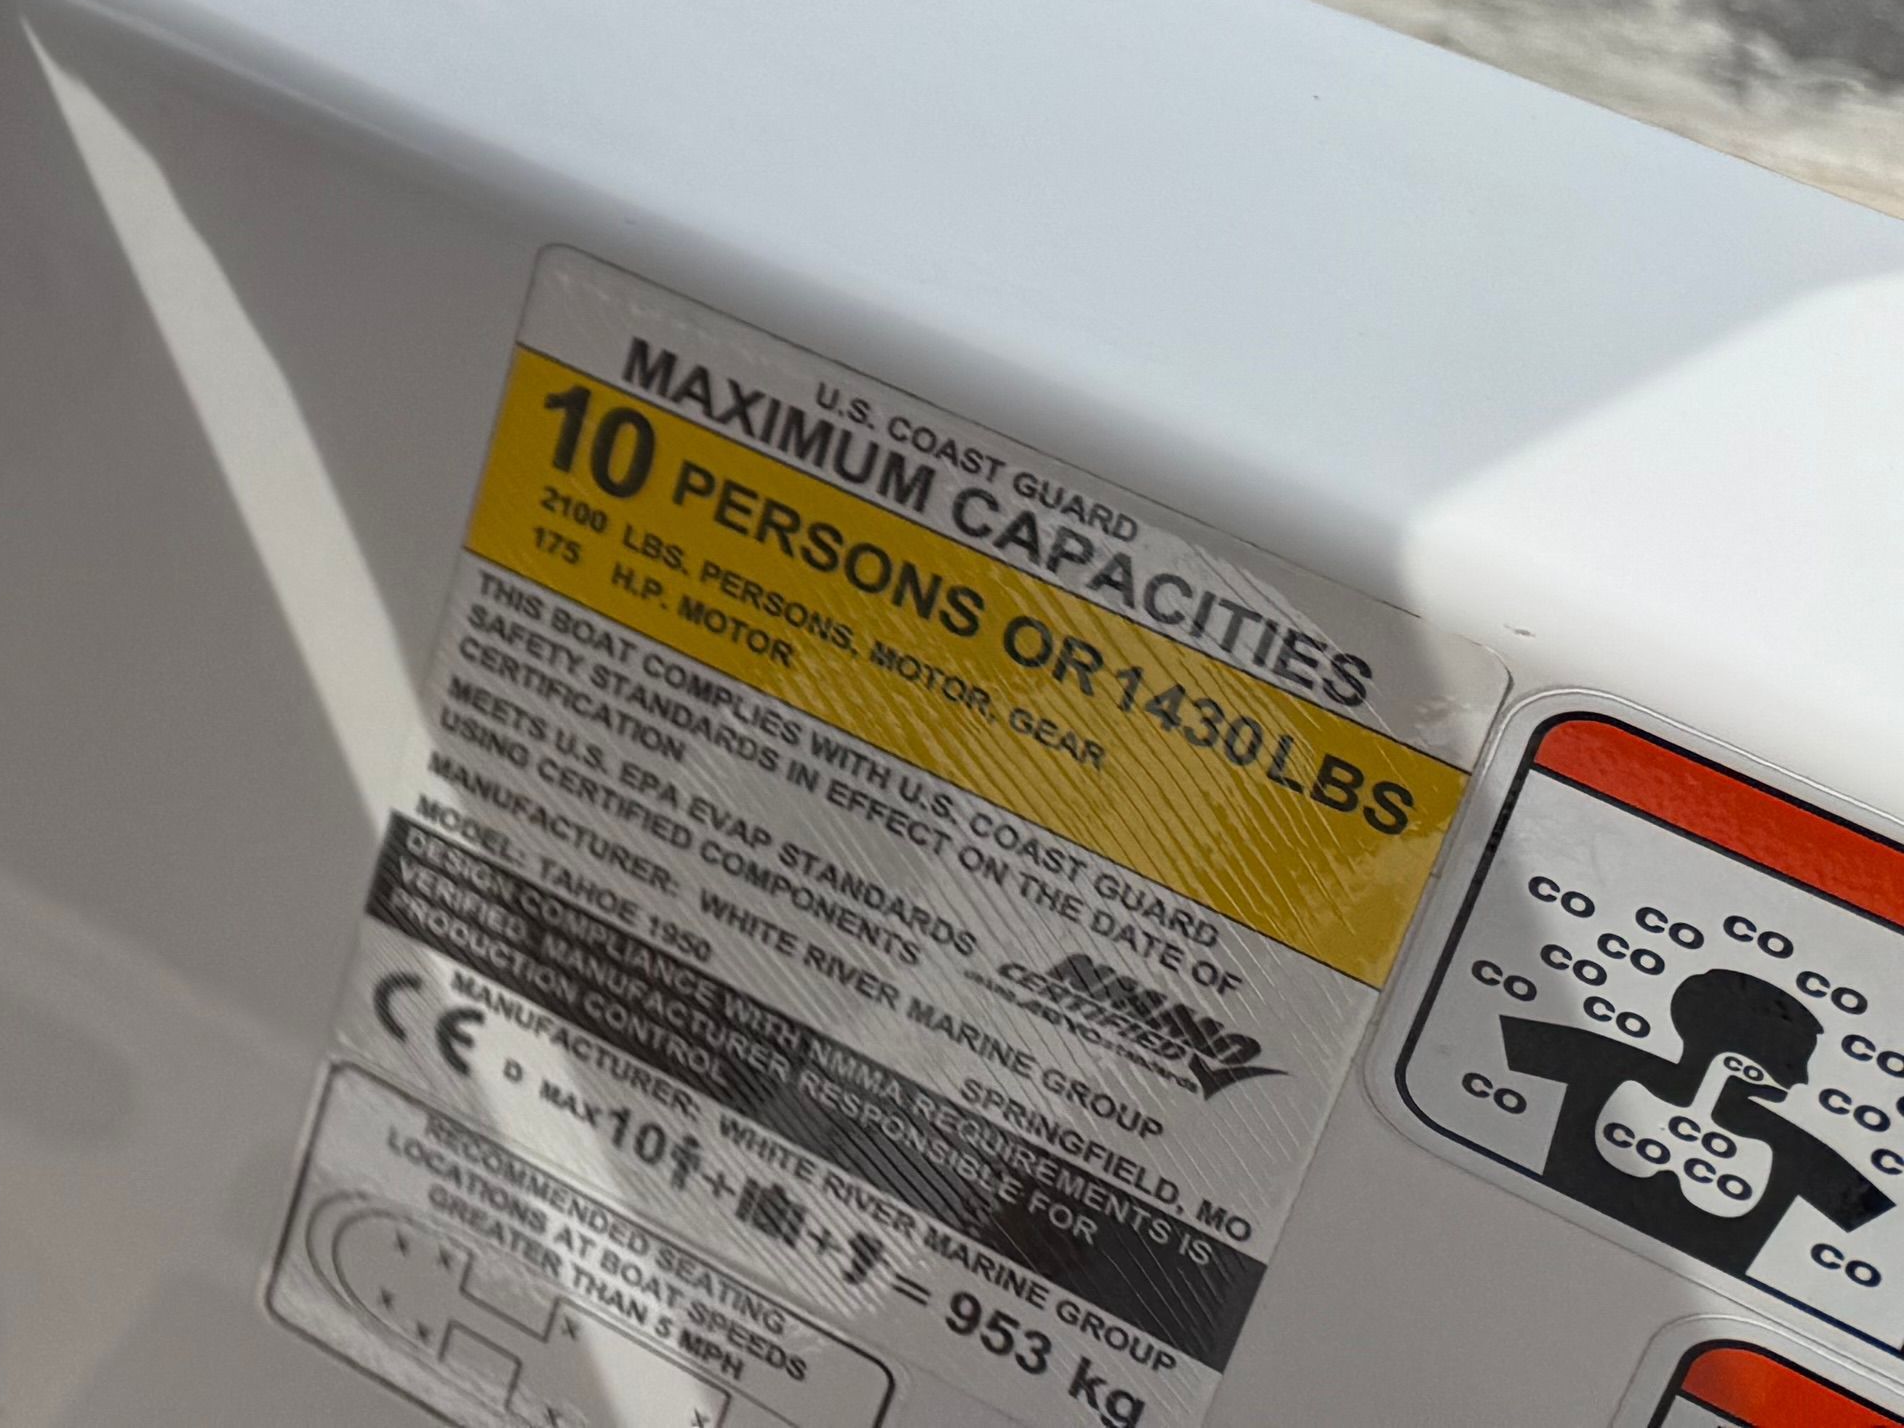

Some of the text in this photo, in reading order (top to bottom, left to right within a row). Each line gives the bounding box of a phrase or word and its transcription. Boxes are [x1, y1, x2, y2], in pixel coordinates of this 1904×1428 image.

[812, 380, 1142, 546] U.S. COAST GUARD
[620, 334, 1379, 713] MAXIMUM CAPACITIES
[527, 522, 796, 670] 175 H.P. MOTOR
[538, 484, 609, 536] 2100
[620, 523, 693, 576] LBS.
[1007, 704, 1108, 771] GEAR
[542, 383, 658, 501] 10
[669, 457, 991, 643] PERSONS
[997, 608, 1110, 698] OR
[1264, 731, 1420, 841] LBS
[456, 632, 688, 766] CERTIFICATION
[465, 600, 1243, 1002] SAFETY STANDARDS IN EFFECT ON THE DATE OF
[473, 568, 1222, 951] THIS BOAT COMPLIES WITH U.S. COAST GUARD
[437, 704, 925, 969] USING CERTIFIED COMPONENTS
[446, 672, 550, 744] MEETS
[616, 758, 684, 811] EPA
[686, 793, 773, 856] EVAP
[775, 837, 980, 959] STANDARDS
[1528, 876, 1595, 918] CO
[1635, 907, 1705, 949] CO
[1723, 915, 1794, 958] CO
[1471, 960, 1537, 1001] CO
[1540, 944, 1608, 986] CO
[1597, 933, 1665, 975] CO
[1795, 971, 1868, 1015] CO
[695, 886, 798, 957] WHITE
[802, 942, 902, 1010] RIVER
[906, 995, 1038, 1080] MARINE
[1040, 1064, 1165, 1145] GROUP
[1583, 996, 1651, 1038] CO
[1841, 1034, 1904, 1077] CO
[1462, 1072, 1527, 1114] CO
[1723, 1056, 1765, 1082] CO
[1818, 1089, 1891, 1132] CO
[795, 1067, 1024, 1207] RESPONSIBLE
[1026, 1189, 1101, 1248] FOR
[806, 1037, 907, 1108] NMMA
[910, 1092, 1173, 1248] REQUIREMENTS
[1177, 1232, 1216, 1269] IS
[957, 1075, 1255, 1246] SPRINGFIELD, MO
[1602, 1122, 1671, 1165] CO
[1668, 1115, 1737, 1158] CO
[1683, 1158, 1753, 1201] CO
[824, 1172, 919, 1239] RIVER
[922, 1225, 1052, 1311] MARINE
[1053, 1296, 1179, 1379] GROUP
[1810, 1243, 1882, 1287] CO
[683, 1294, 812, 1386] SPEEDS
[940, 1285, 1057, 1381] 953
[1066, 1355, 1147, 1428] kg
